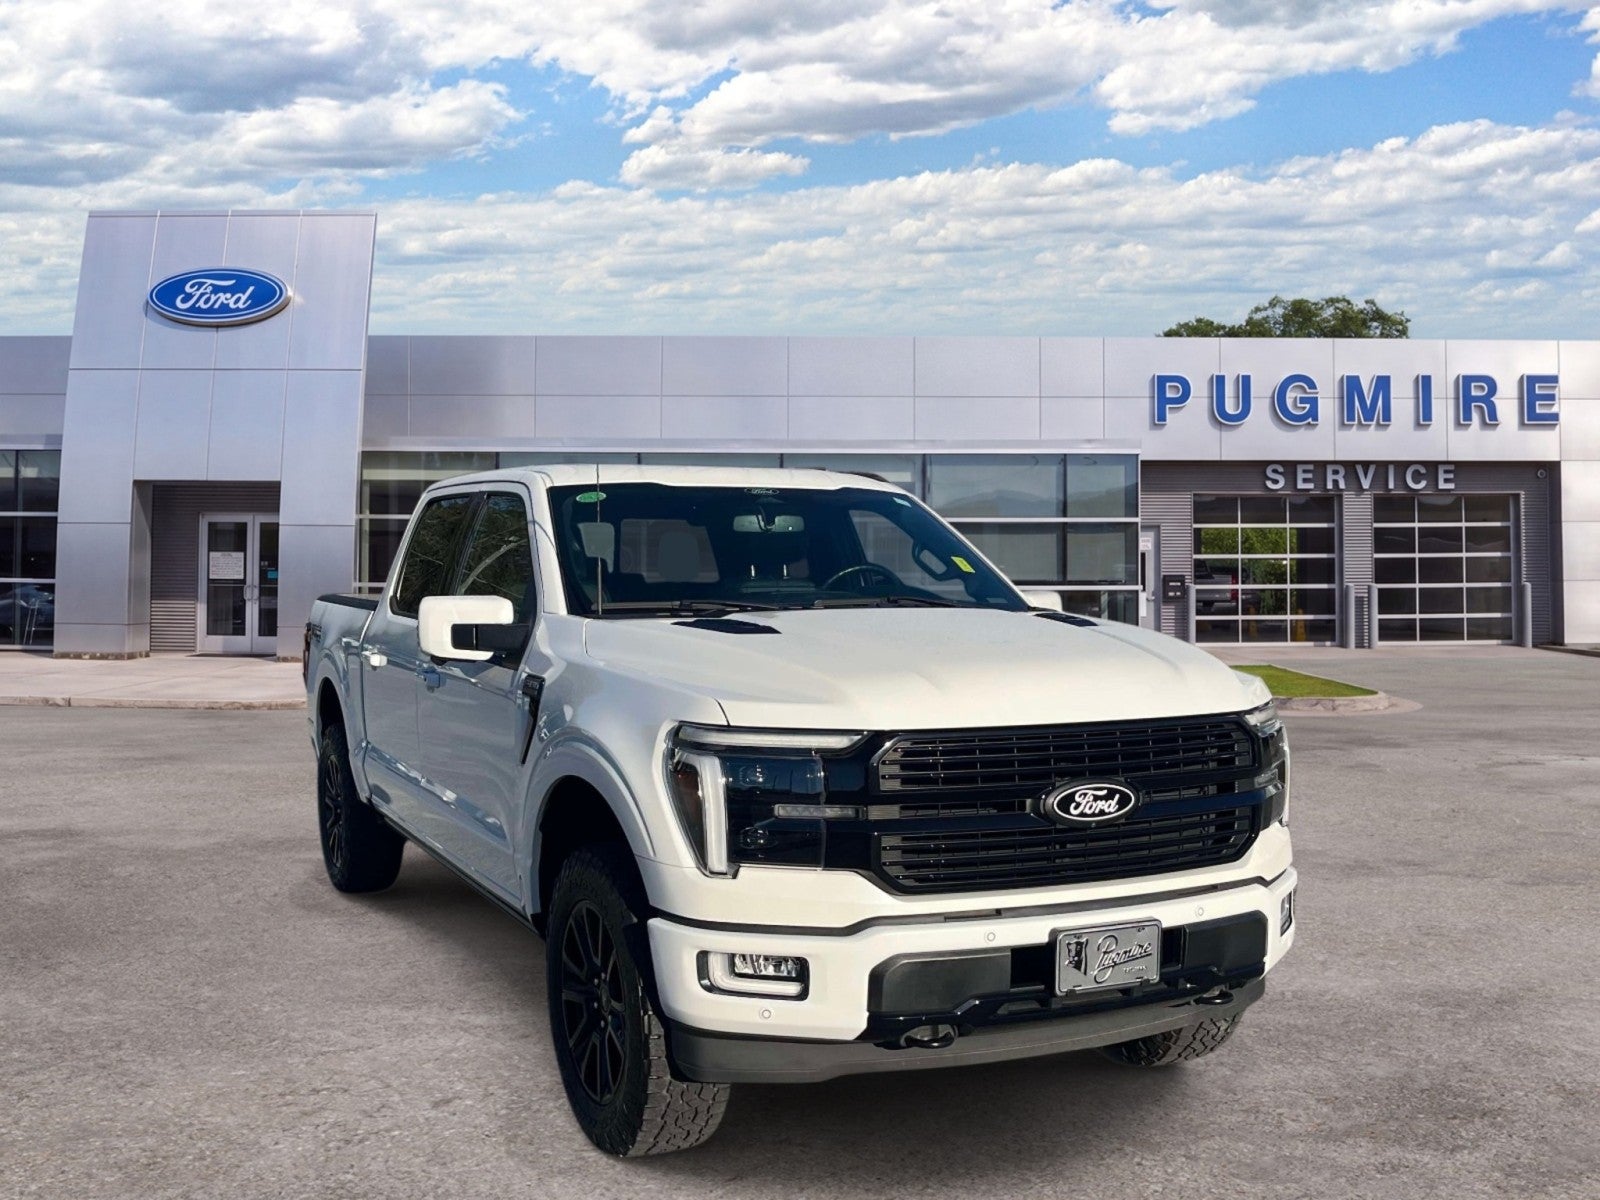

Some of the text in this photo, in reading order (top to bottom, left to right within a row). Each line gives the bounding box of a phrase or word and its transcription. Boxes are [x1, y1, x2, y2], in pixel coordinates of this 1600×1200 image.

[175, 278, 255, 309] Ford
[1153, 373, 1560, 425] PUGMIRE
[1265, 464, 1456, 490] SERVICE
[1070, 789, 1120, 815] Ford
[1093, 934, 1152, 984] Pugmire
